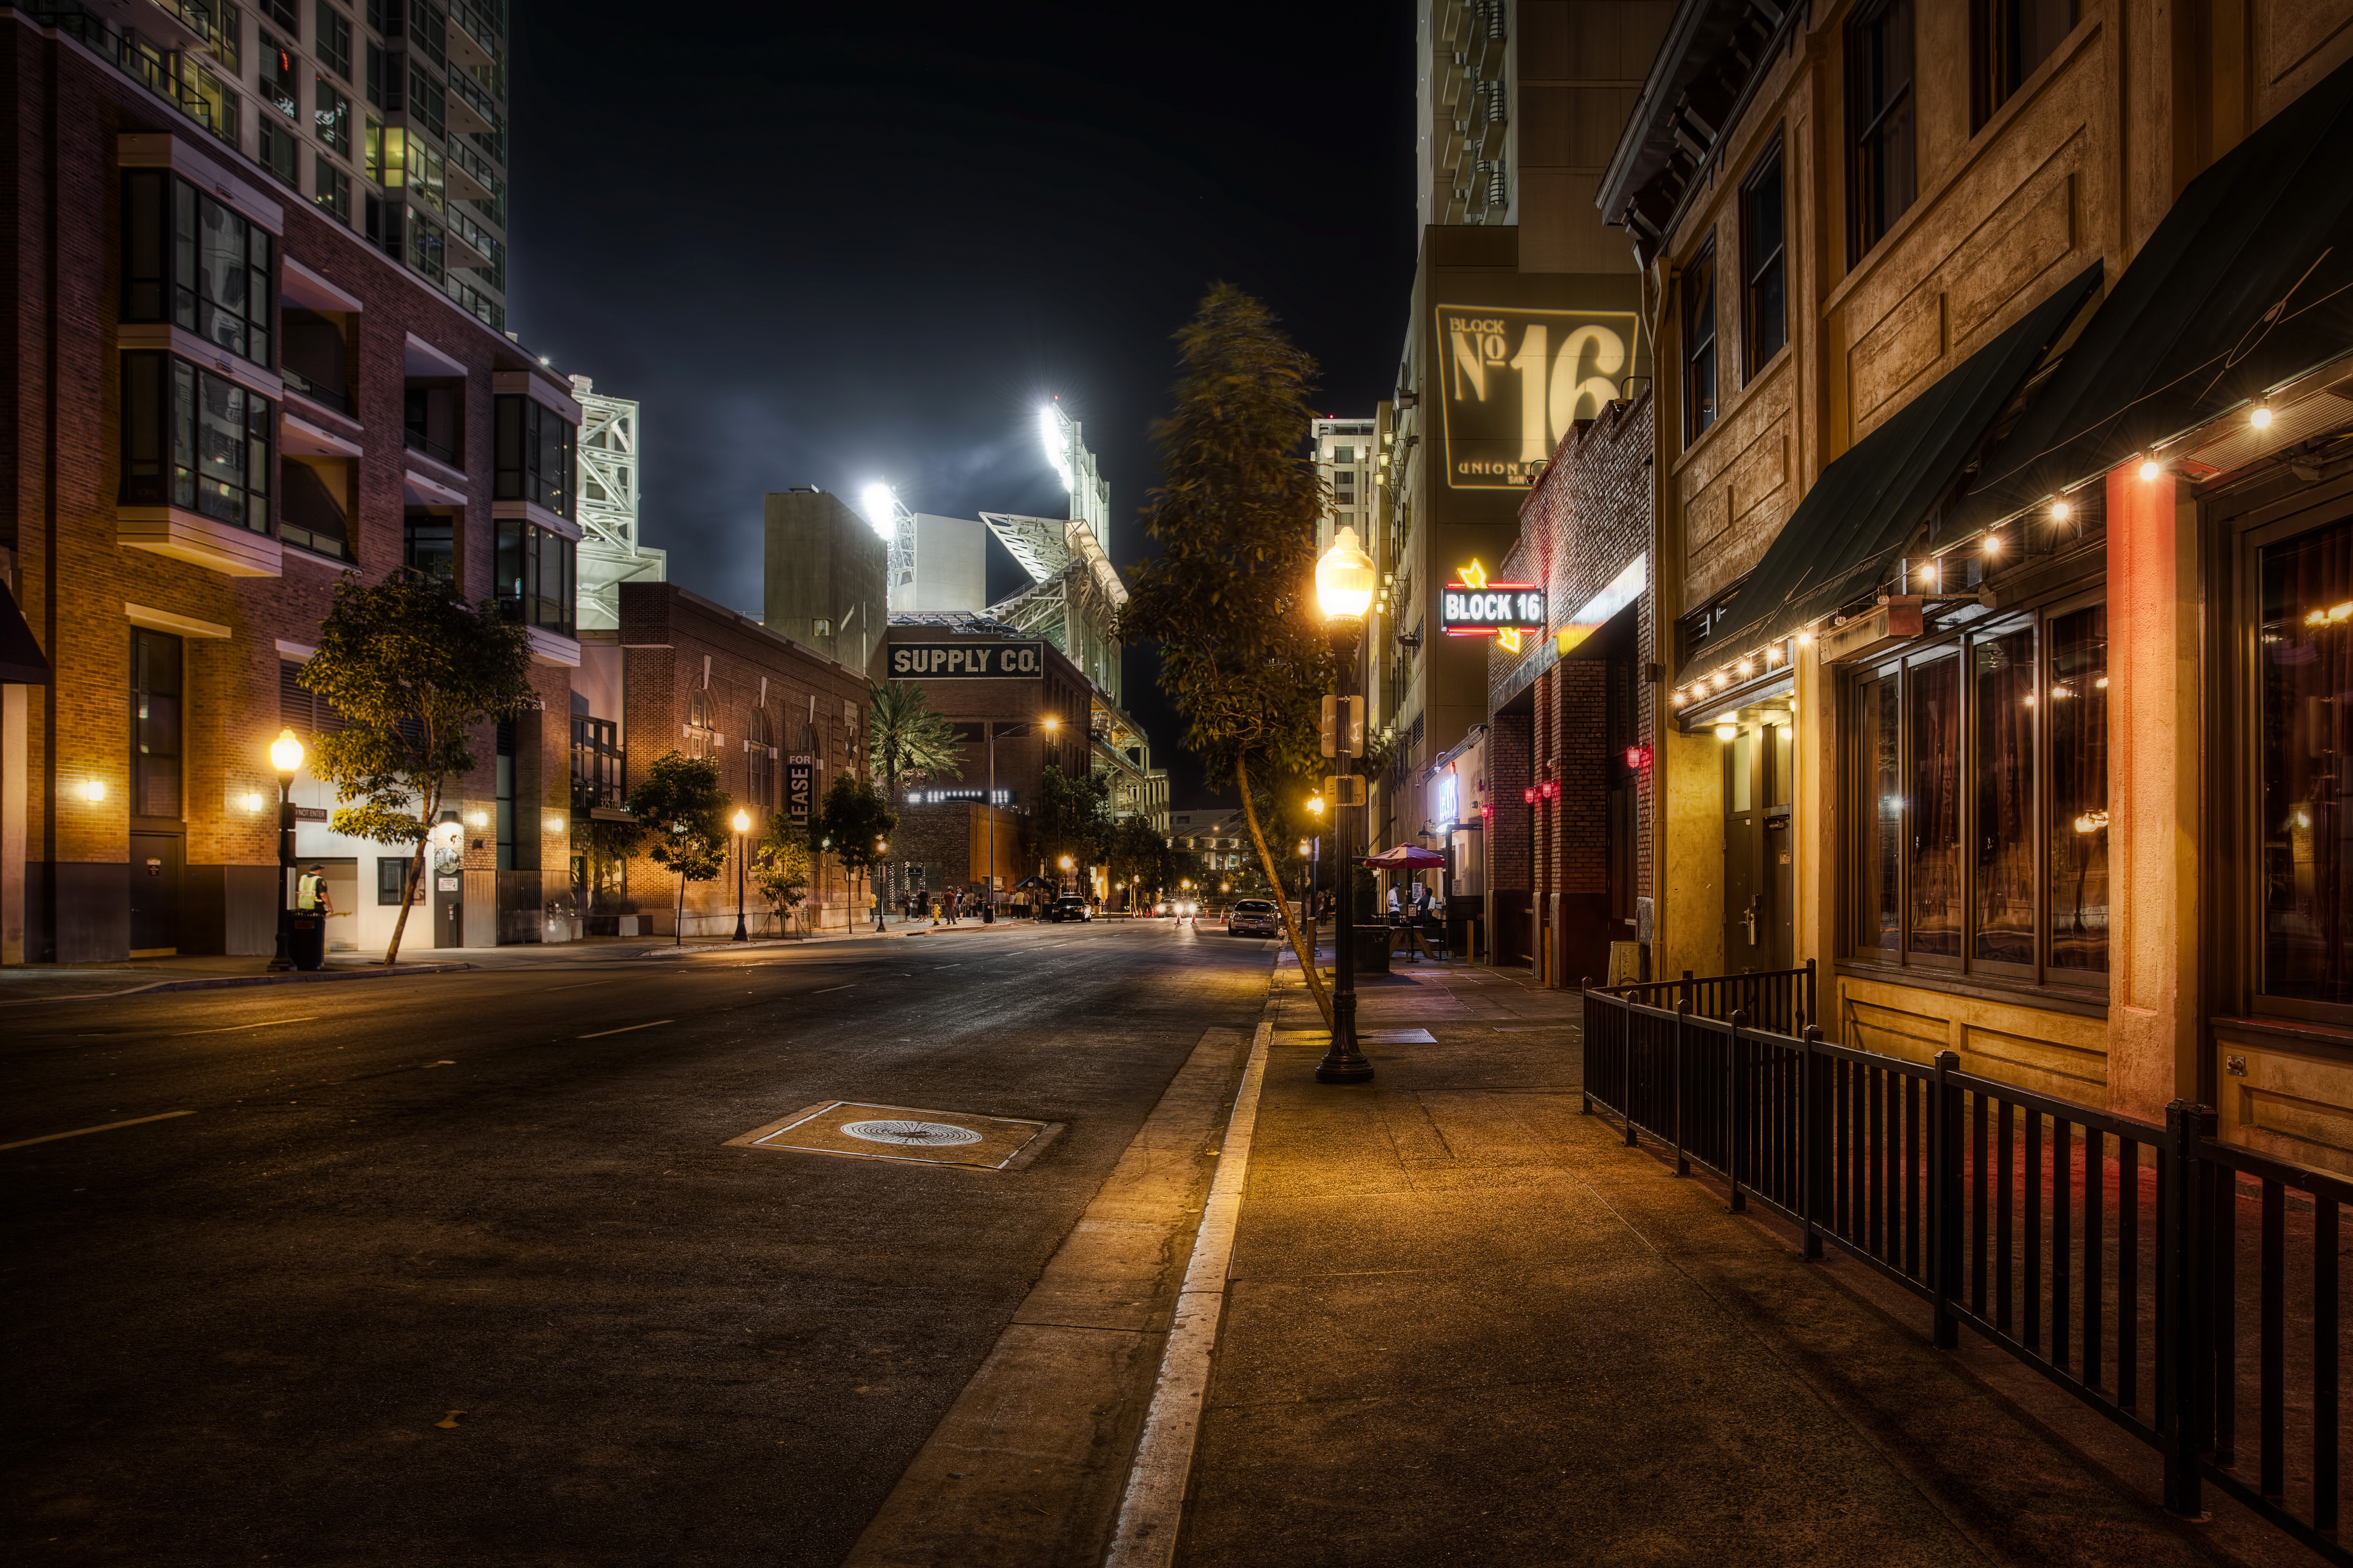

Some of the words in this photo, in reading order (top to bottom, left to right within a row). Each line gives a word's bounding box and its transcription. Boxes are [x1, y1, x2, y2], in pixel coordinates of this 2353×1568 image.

[1450, 318, 1505, 334] BLOCK
[1510, 324, 1625, 463] 16
[1459, 462, 1518, 475] UNION
[1446, 594, 1513, 620] BLOCK
[1517, 594, 1540, 620] 16
[894, 650, 992, 672] SUPPLY
[1001, 649, 1040, 672] CO.
[790, 755, 811, 764] FOR
[792, 768, 808, 825] LEASE
